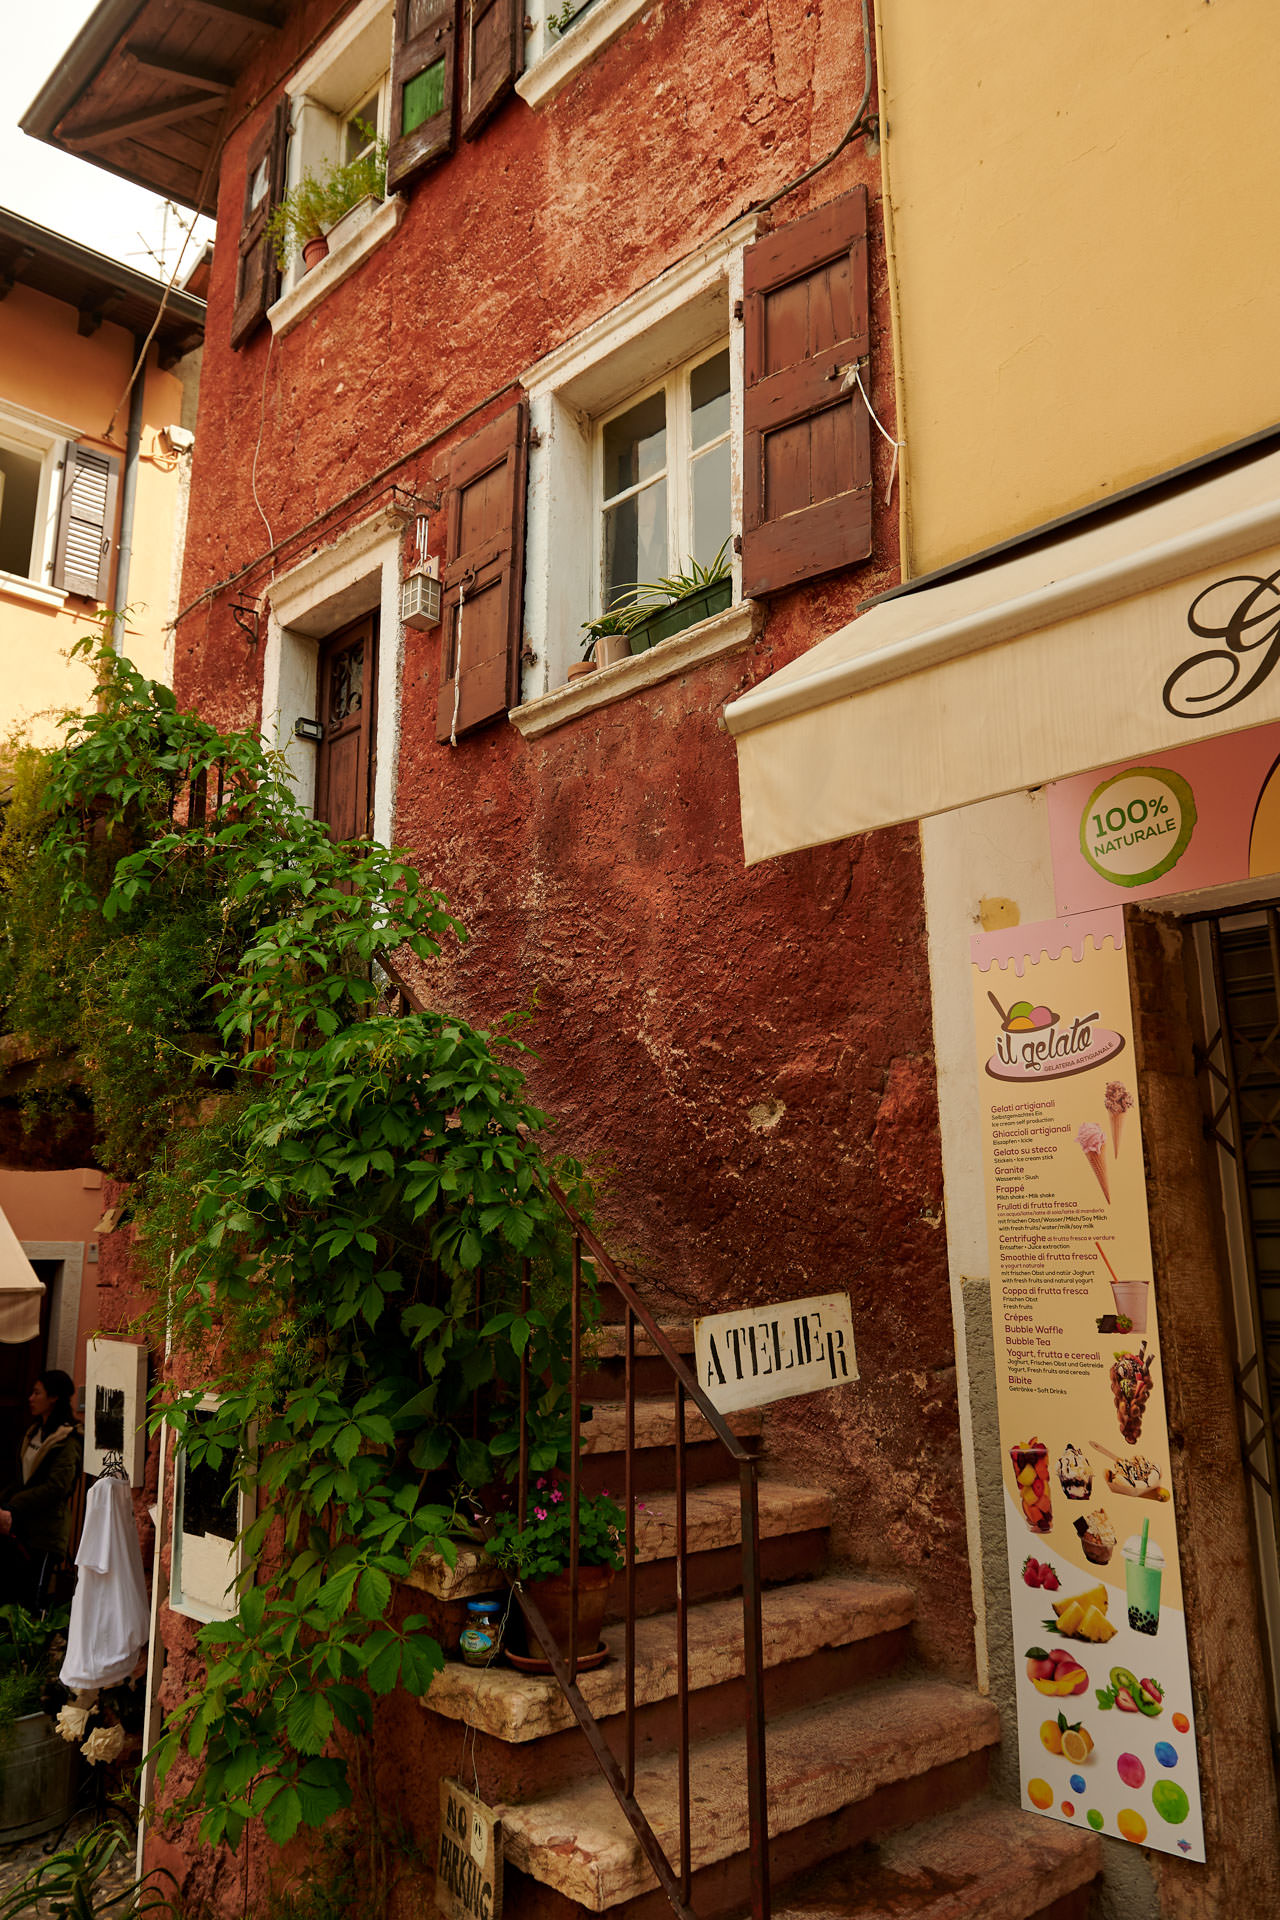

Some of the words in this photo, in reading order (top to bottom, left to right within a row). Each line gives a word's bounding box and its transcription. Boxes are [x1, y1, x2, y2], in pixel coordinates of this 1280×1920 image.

[1092, 795, 1169, 838] 100%
[1094, 818, 1177, 857] NATURALE
[996, 1033, 1018, 1065] il
[1021, 1012, 1100, 1071] gelato
[1044, 1060, 1076, 1072] GELATERIA
[1076, 1041, 1114, 1064] ARTIGIANALE
[991, 1104, 1014, 1113] Gelati
[1015, 1100, 1056, 1112] artigianali
[992, 1128, 1029, 1139] Ghiaccioli
[1030, 1124, 1072, 1137] artigianali
[993, 1148, 1020, 1157] Gelato
[1031, 1145, 1058, 1154] stecco
[994, 1165, 1025, 1175] Granite
[995, 1183, 1025, 1194] Frappé
[996, 1202, 1022, 1211] Frullati
[1022, 1201, 1030, 1210] di
[1030, 1201, 1053, 1209] frutta
[1053, 1200, 1078, 1208] fresca
[999, 1234, 1046, 1246] Centrifughe
[1000, 1253, 1037, 1261] Smoothie
[1037, 1253, 1045, 1261] di
[1046, 1253, 1071, 1261] frutta
[1071, 1252, 1098, 1260] fresca
[1002, 1286, 1028, 1296] Coppa
[1028, 1286, 1037, 1295] di
[1037, 1286, 1062, 1295] frutta
[1062, 1287, 1089, 1295] fresca
[1005, 1325, 1033, 1334] Bubble
[1035, 1326, 1064, 1335] Waffle
[1005, 1337, 1034, 1346] Bubble
[1036, 1338, 1051, 1346] Tea
[707, 1312, 848, 1387] ATELIER
[1007, 1348, 1036, 1360] Yogurt,
[1037, 1350, 1063, 1359] frutta
[1071, 1352, 1101, 1361] cereali
[1008, 1376, 1033, 1385] Bibite
[446, 1794, 467, 1840] NO
[440, 1832, 492, 1920] PARKING
